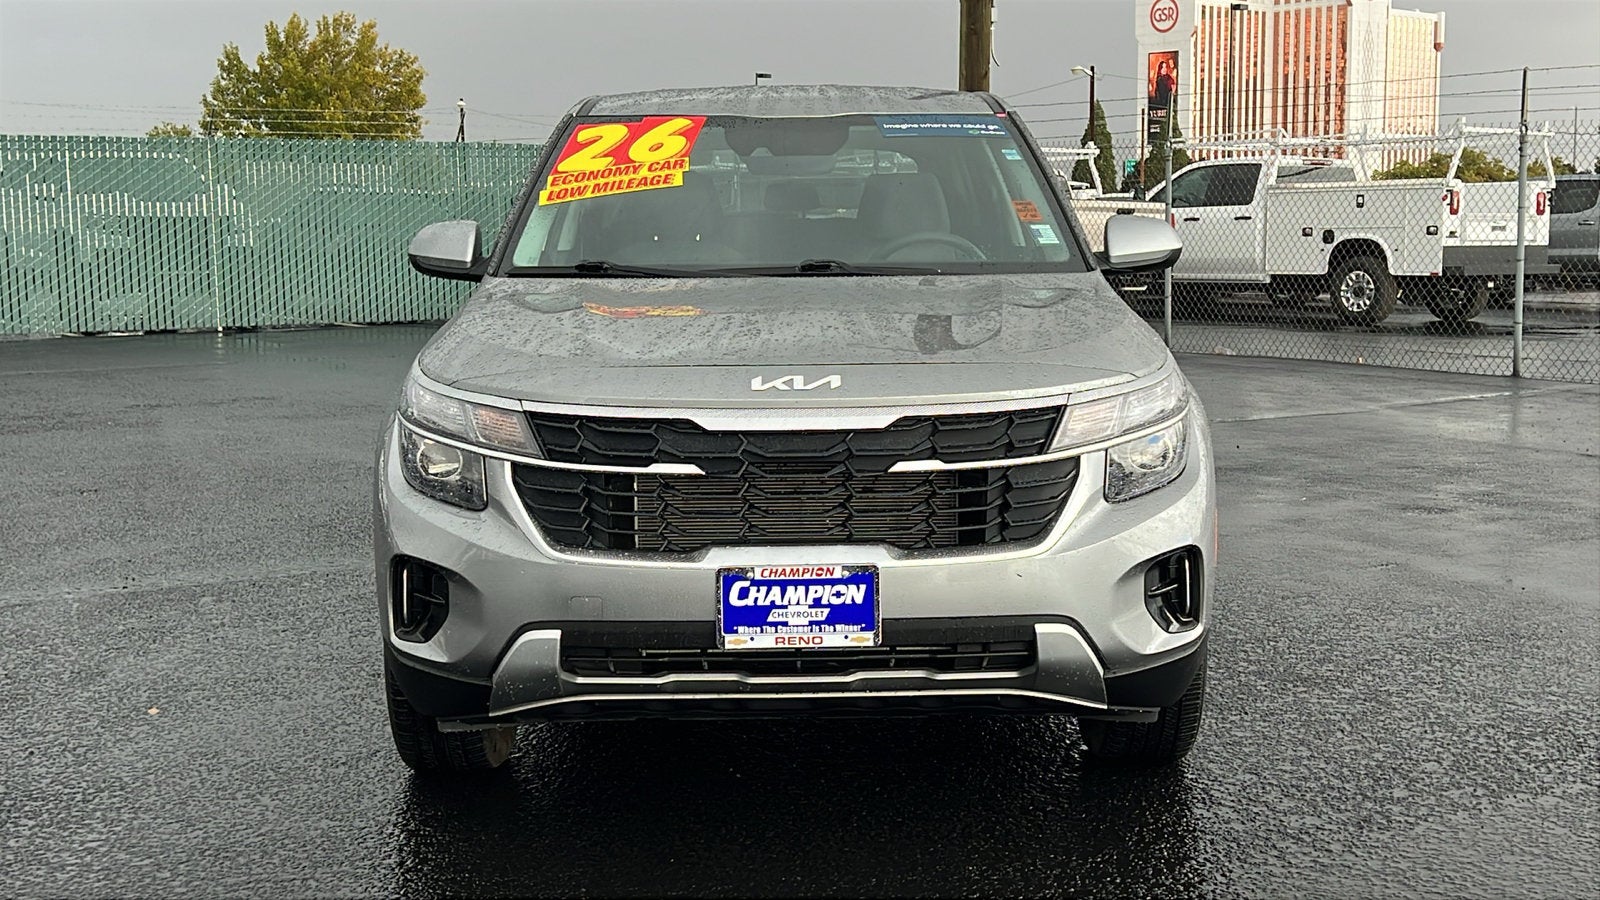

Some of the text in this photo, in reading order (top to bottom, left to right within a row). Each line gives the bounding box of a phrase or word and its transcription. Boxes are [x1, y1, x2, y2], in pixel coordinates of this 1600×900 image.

[1153, 7, 1176, 23] GSR
[557, 117, 694, 172] 26
[550, 159, 687, 187] ECONOMY CAR
[546, 173, 674, 201] LOW MILEAGE
[751, 375, 842, 391] KIA
[760, 567, 835, 578] CHAMPION
[729, 580, 867, 607] CHAMPION
[771, 610, 824, 619] CHEVROLET
[762, 625, 775, 634] The
[777, 625, 811, 633] Customer
[821, 624, 833, 632] The
[775, 636, 824, 645] RENO
